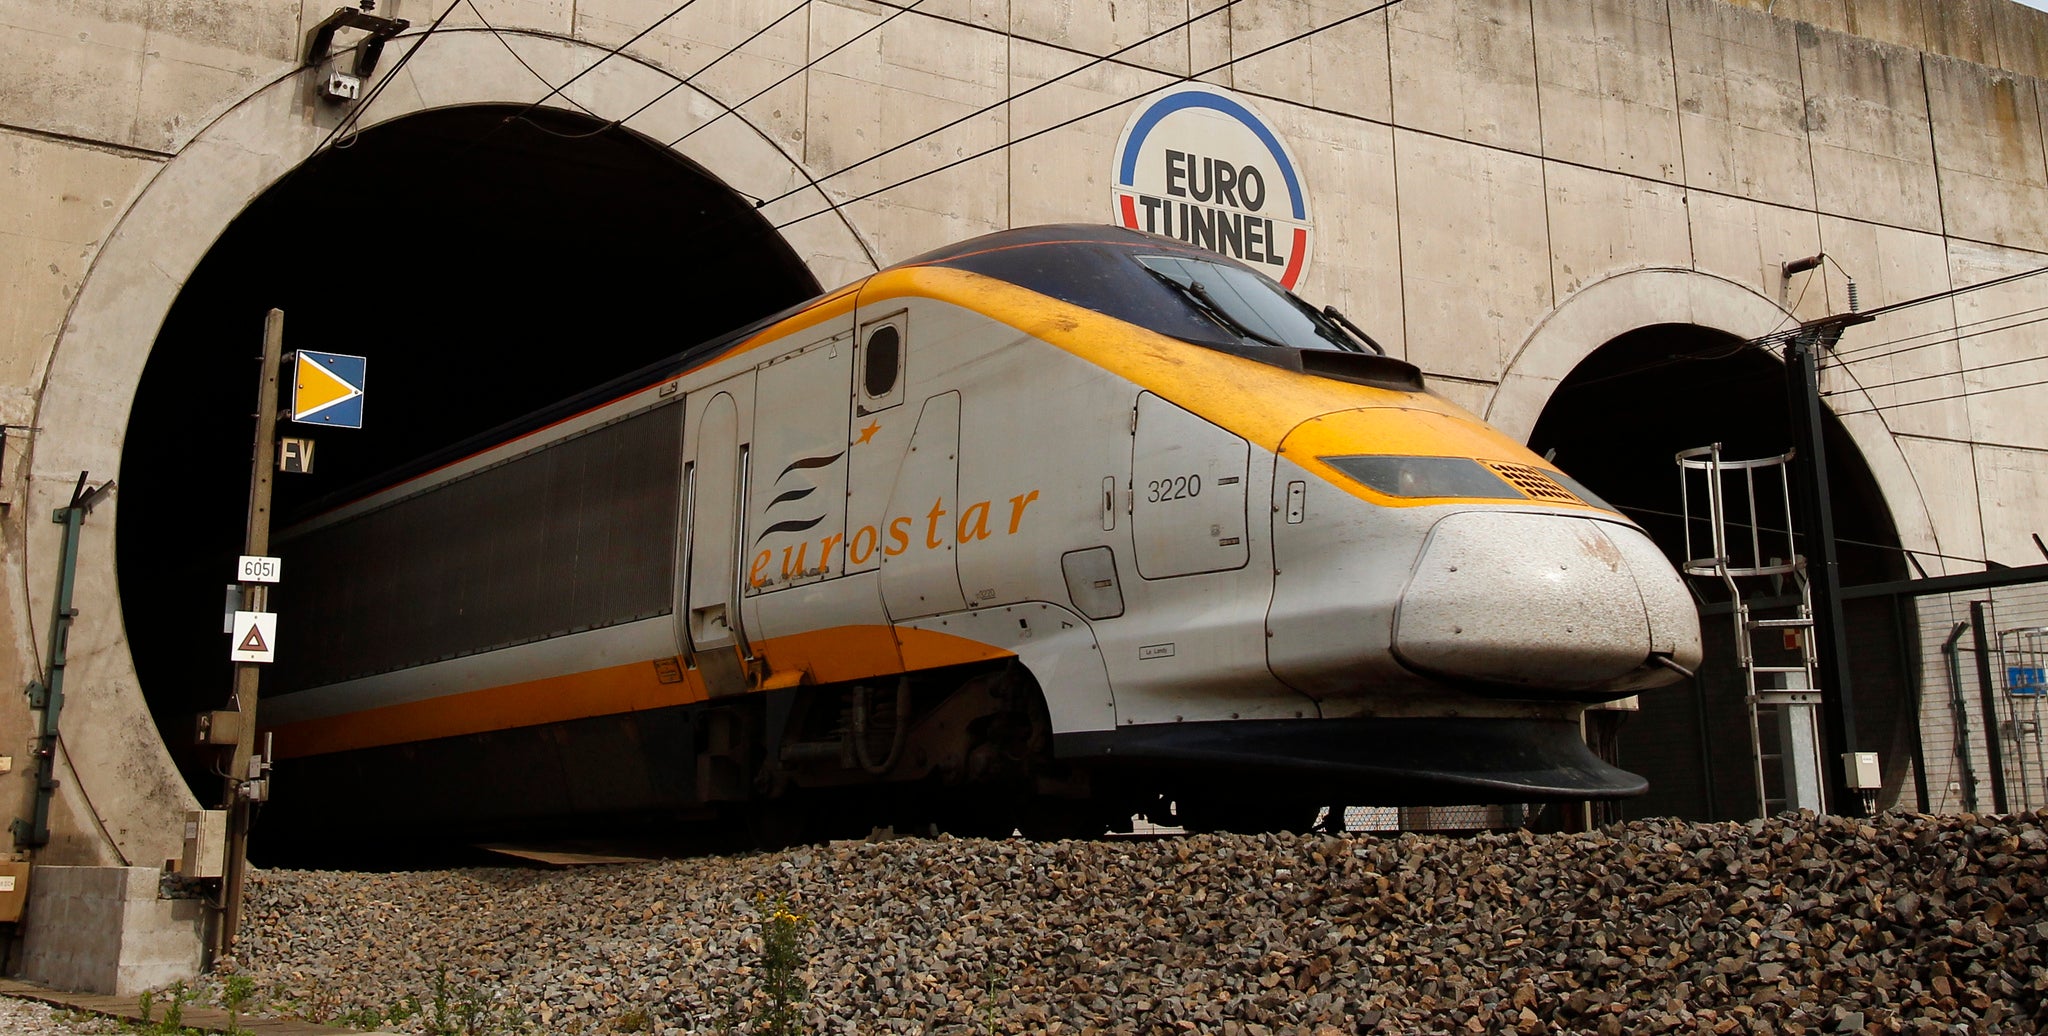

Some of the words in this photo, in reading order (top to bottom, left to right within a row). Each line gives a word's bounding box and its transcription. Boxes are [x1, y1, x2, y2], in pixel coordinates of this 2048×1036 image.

[1166, 149, 1266, 212] EURO
[1139, 195, 1285, 267] TUNNEL
[280, 438, 315, 473] FV
[1147, 473, 1202, 503] 3220
[749, 489, 1040, 588] eurostar
[244, 561, 275, 577] 6051
